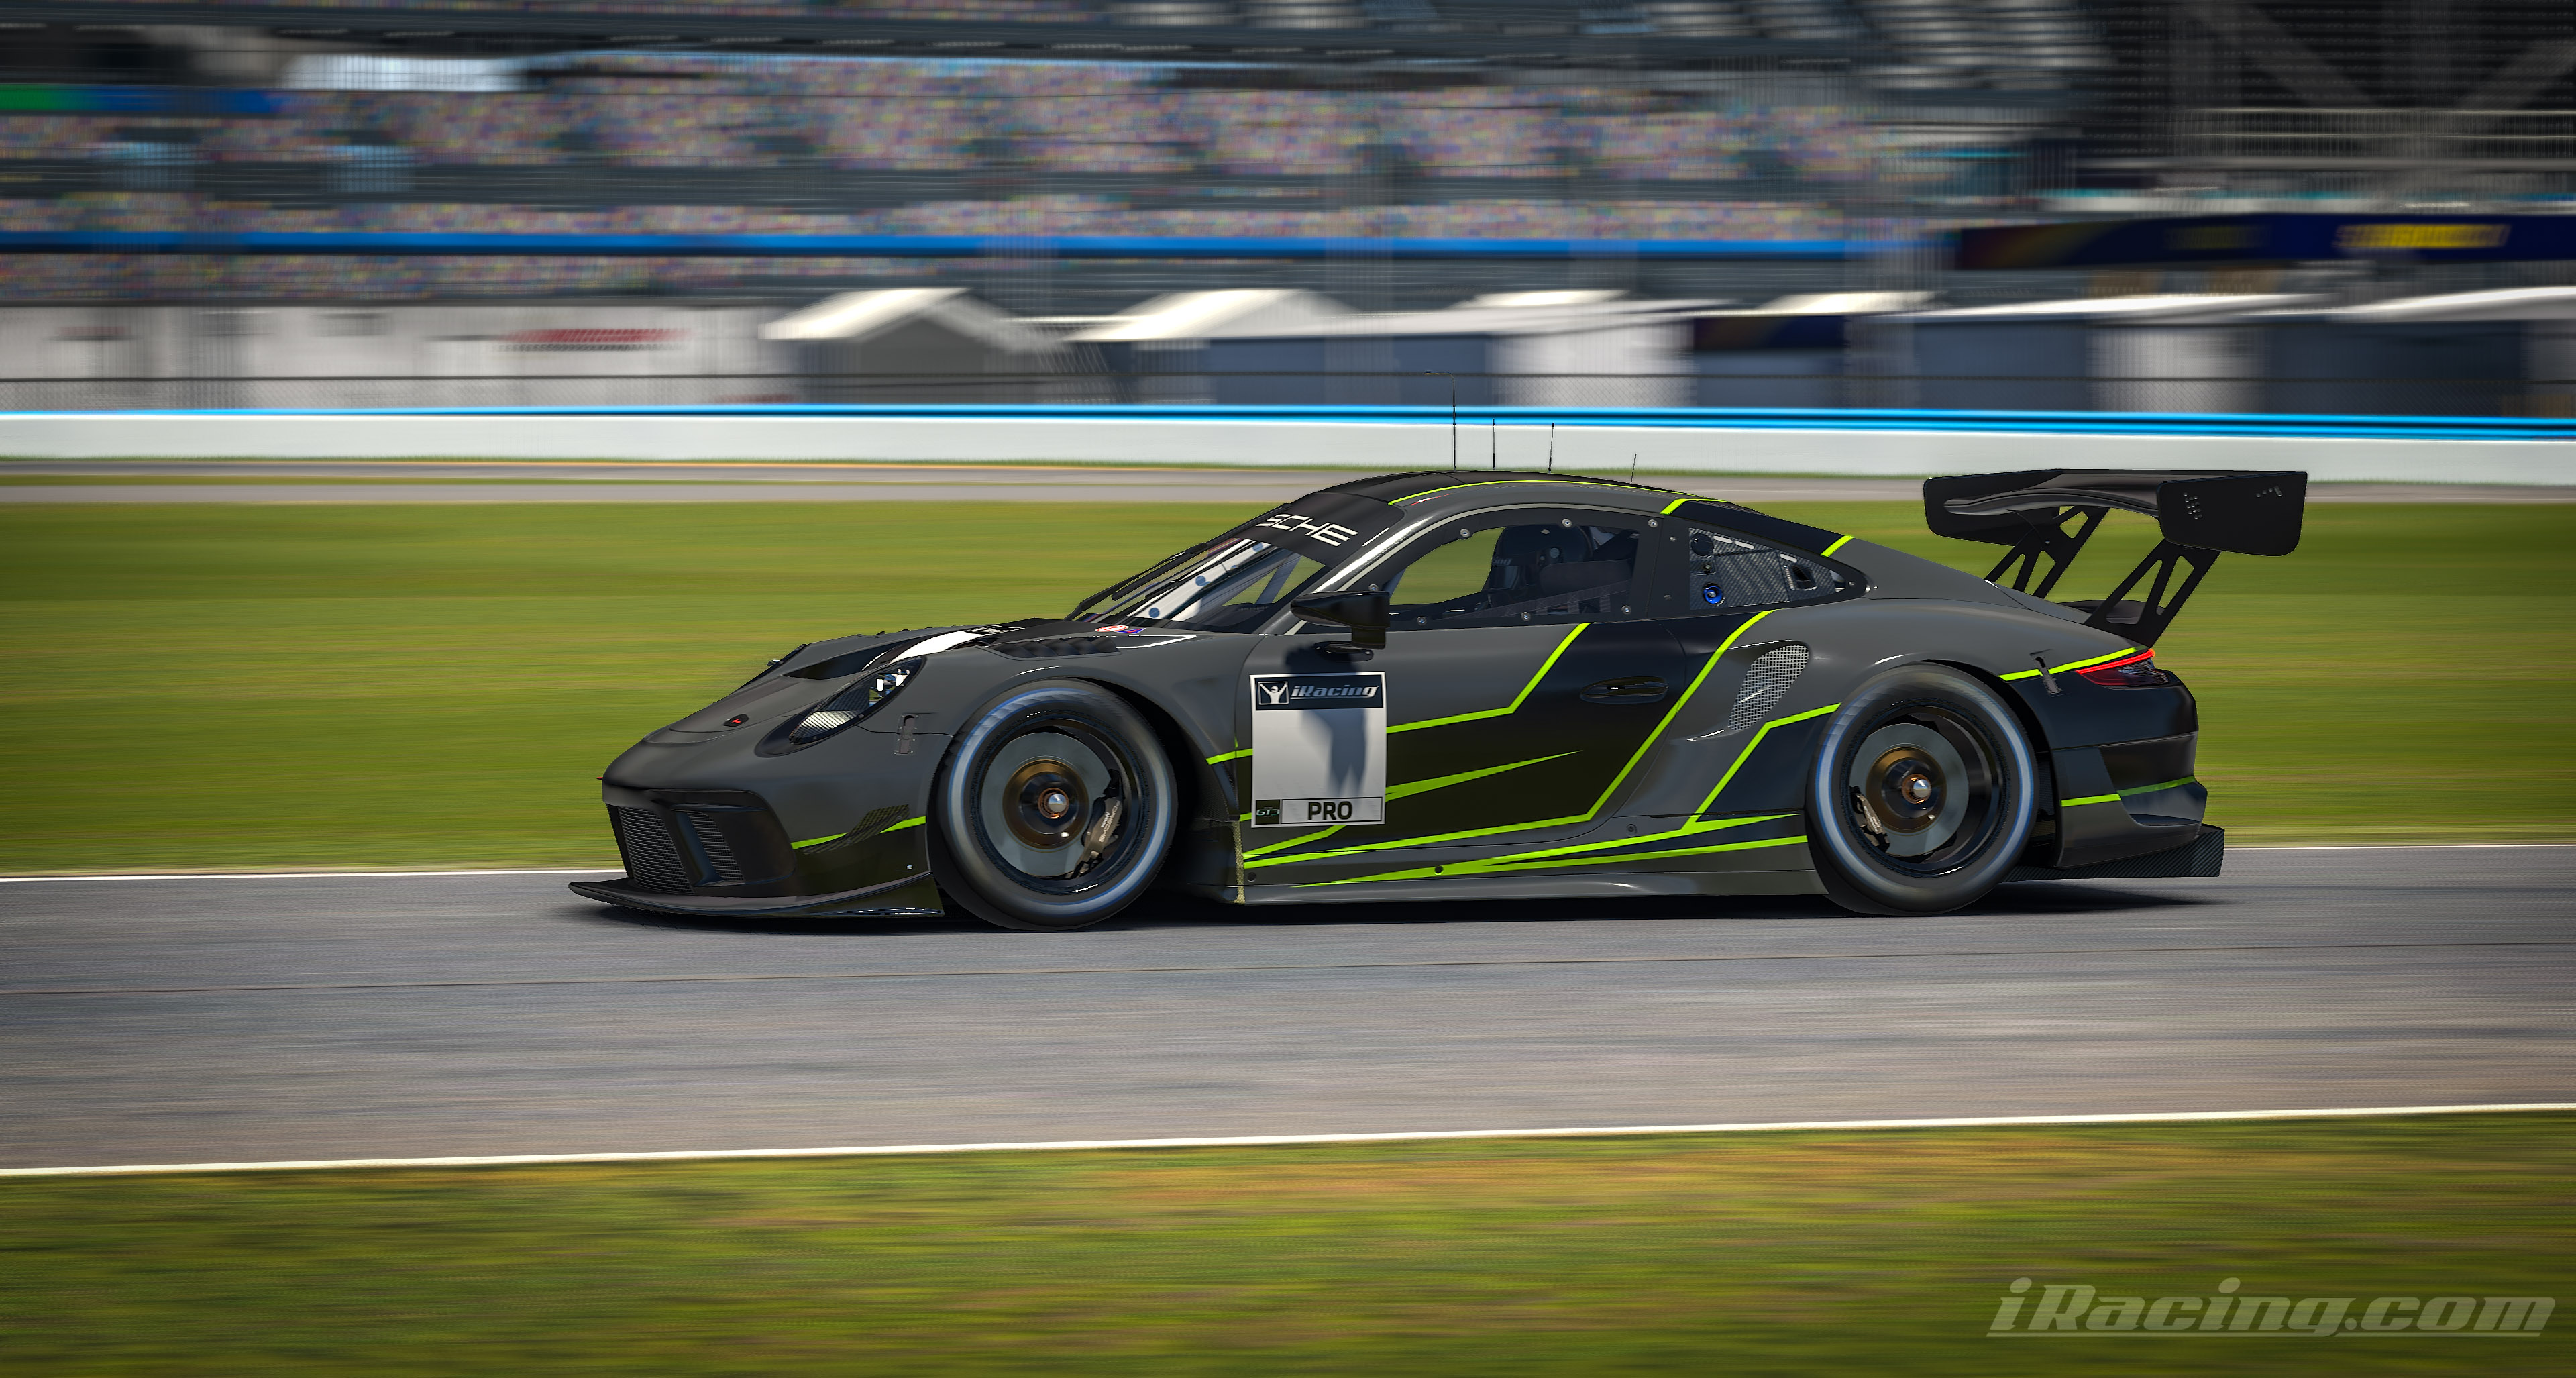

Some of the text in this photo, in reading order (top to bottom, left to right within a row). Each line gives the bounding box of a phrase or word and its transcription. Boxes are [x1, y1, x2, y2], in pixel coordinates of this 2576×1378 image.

[1290, 684, 1379, 699] iRacing
[1256, 808, 1280, 816] GT3
[1308, 801, 1352, 821] PRO
